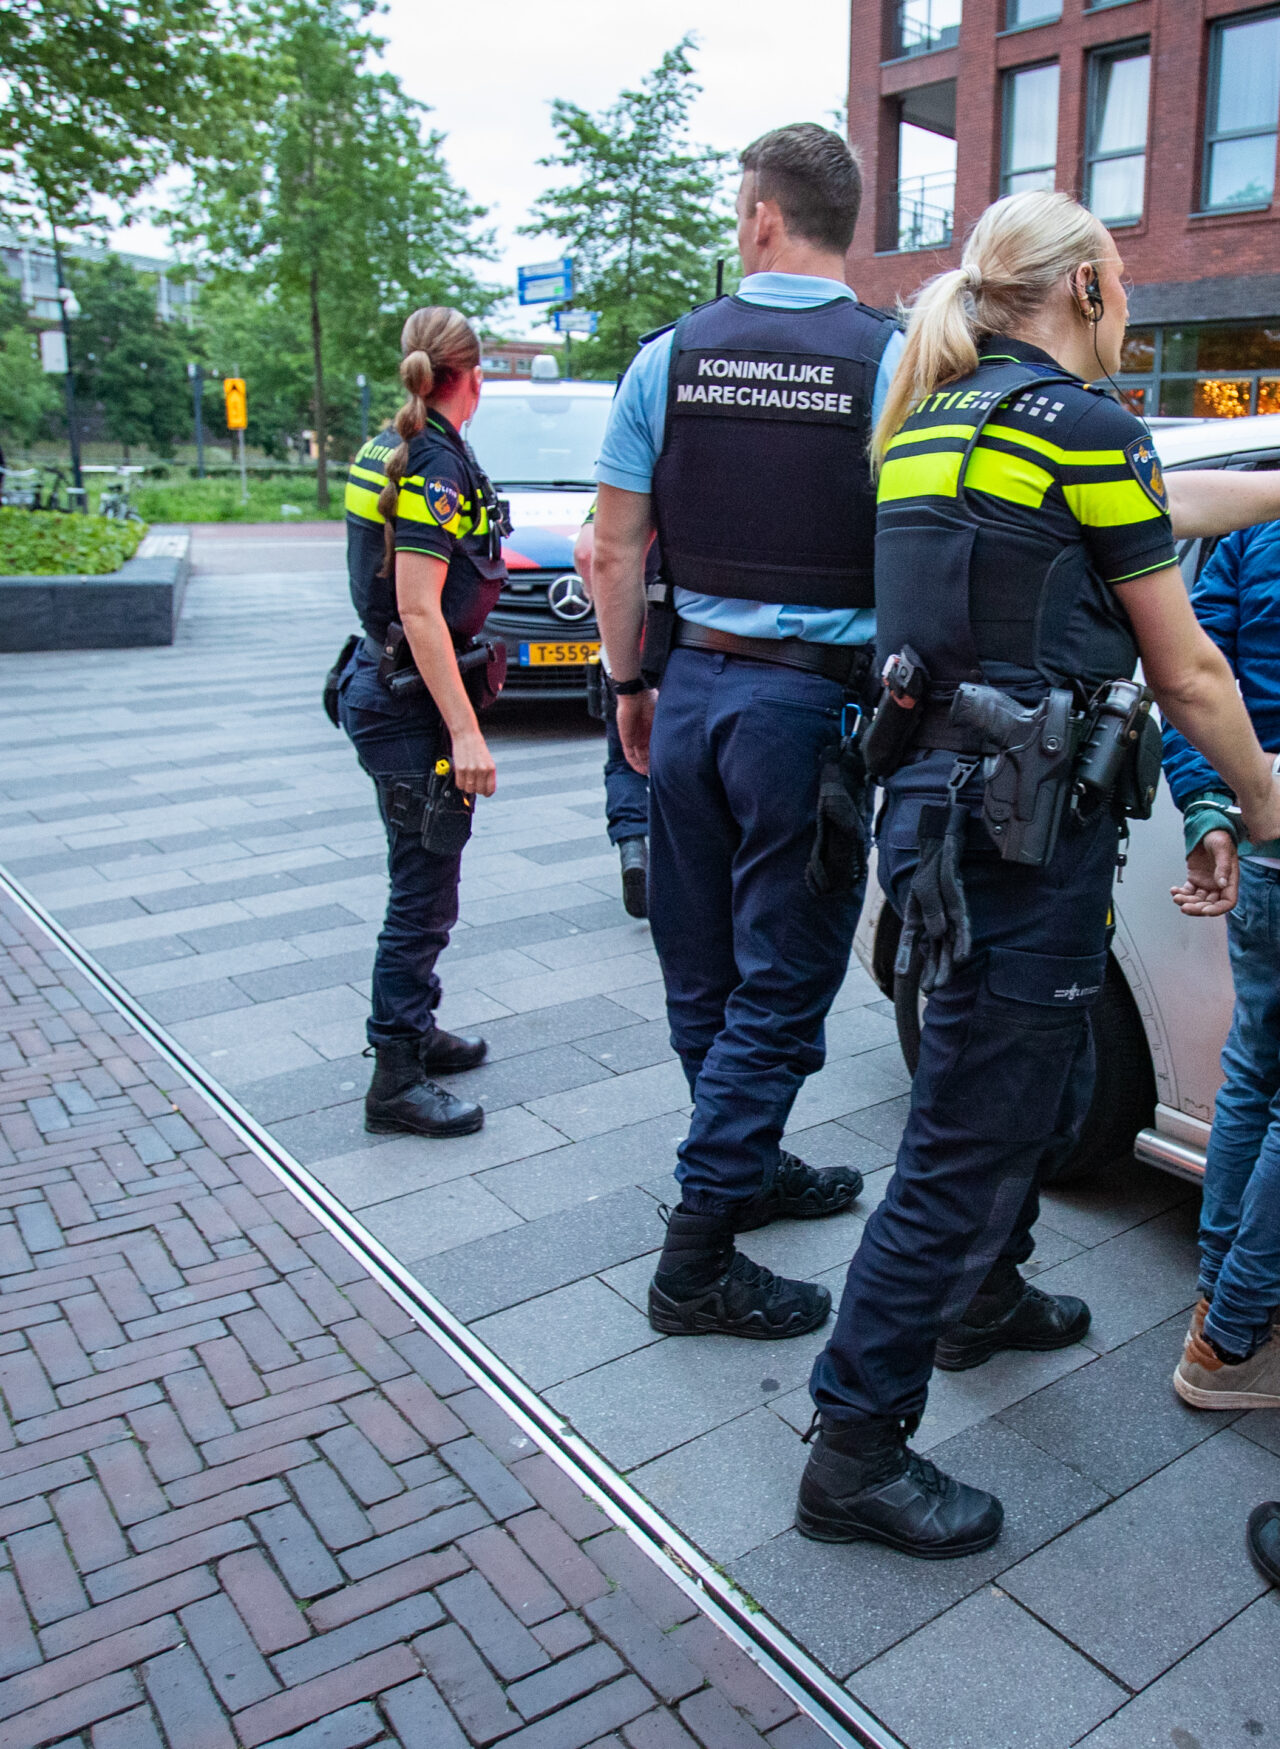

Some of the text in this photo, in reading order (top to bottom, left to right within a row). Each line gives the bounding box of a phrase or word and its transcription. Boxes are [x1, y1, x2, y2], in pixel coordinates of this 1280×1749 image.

[698, 358, 834, 385] KONINKLIJKE
[677, 384, 852, 414] MARECHAUSSEE
[909, 390, 982, 416] ITIE
